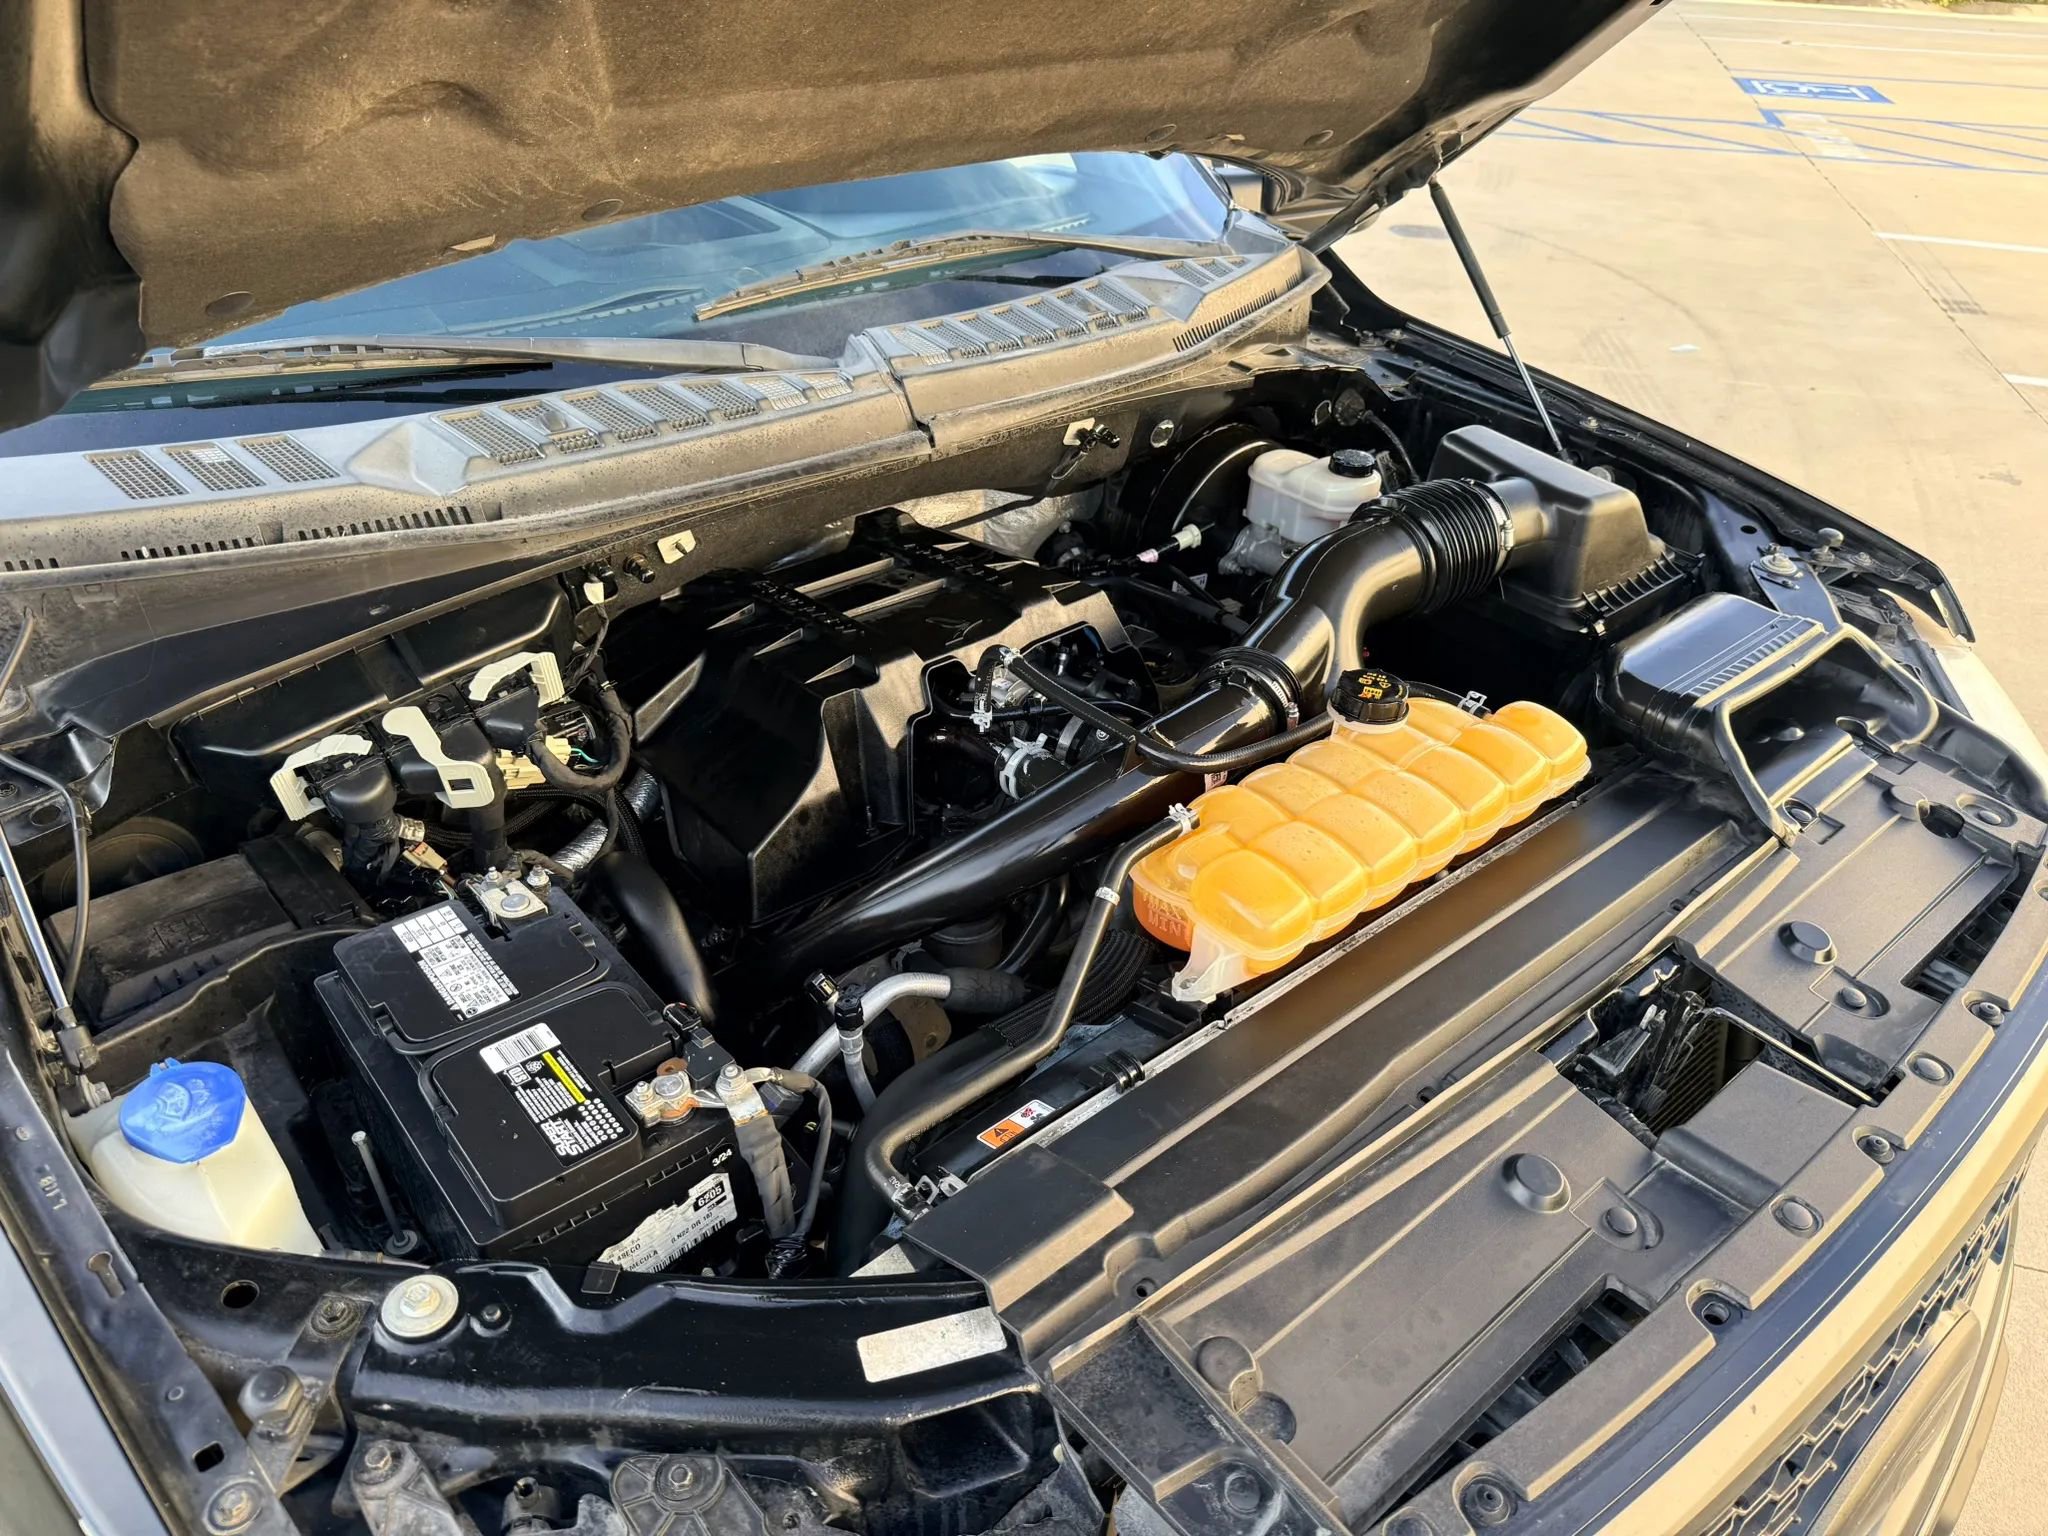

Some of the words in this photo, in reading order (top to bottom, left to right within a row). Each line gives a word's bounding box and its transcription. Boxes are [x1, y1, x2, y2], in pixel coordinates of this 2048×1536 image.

[1148, 909, 1181, 936] MIN
[508, 1065, 529, 1084] STD
[540, 1121, 567, 1156] SUPER
[548, 1118, 581, 1156] START
[712, 1149, 732, 1167] 3/24
[698, 1186, 722, 1207] 6205
